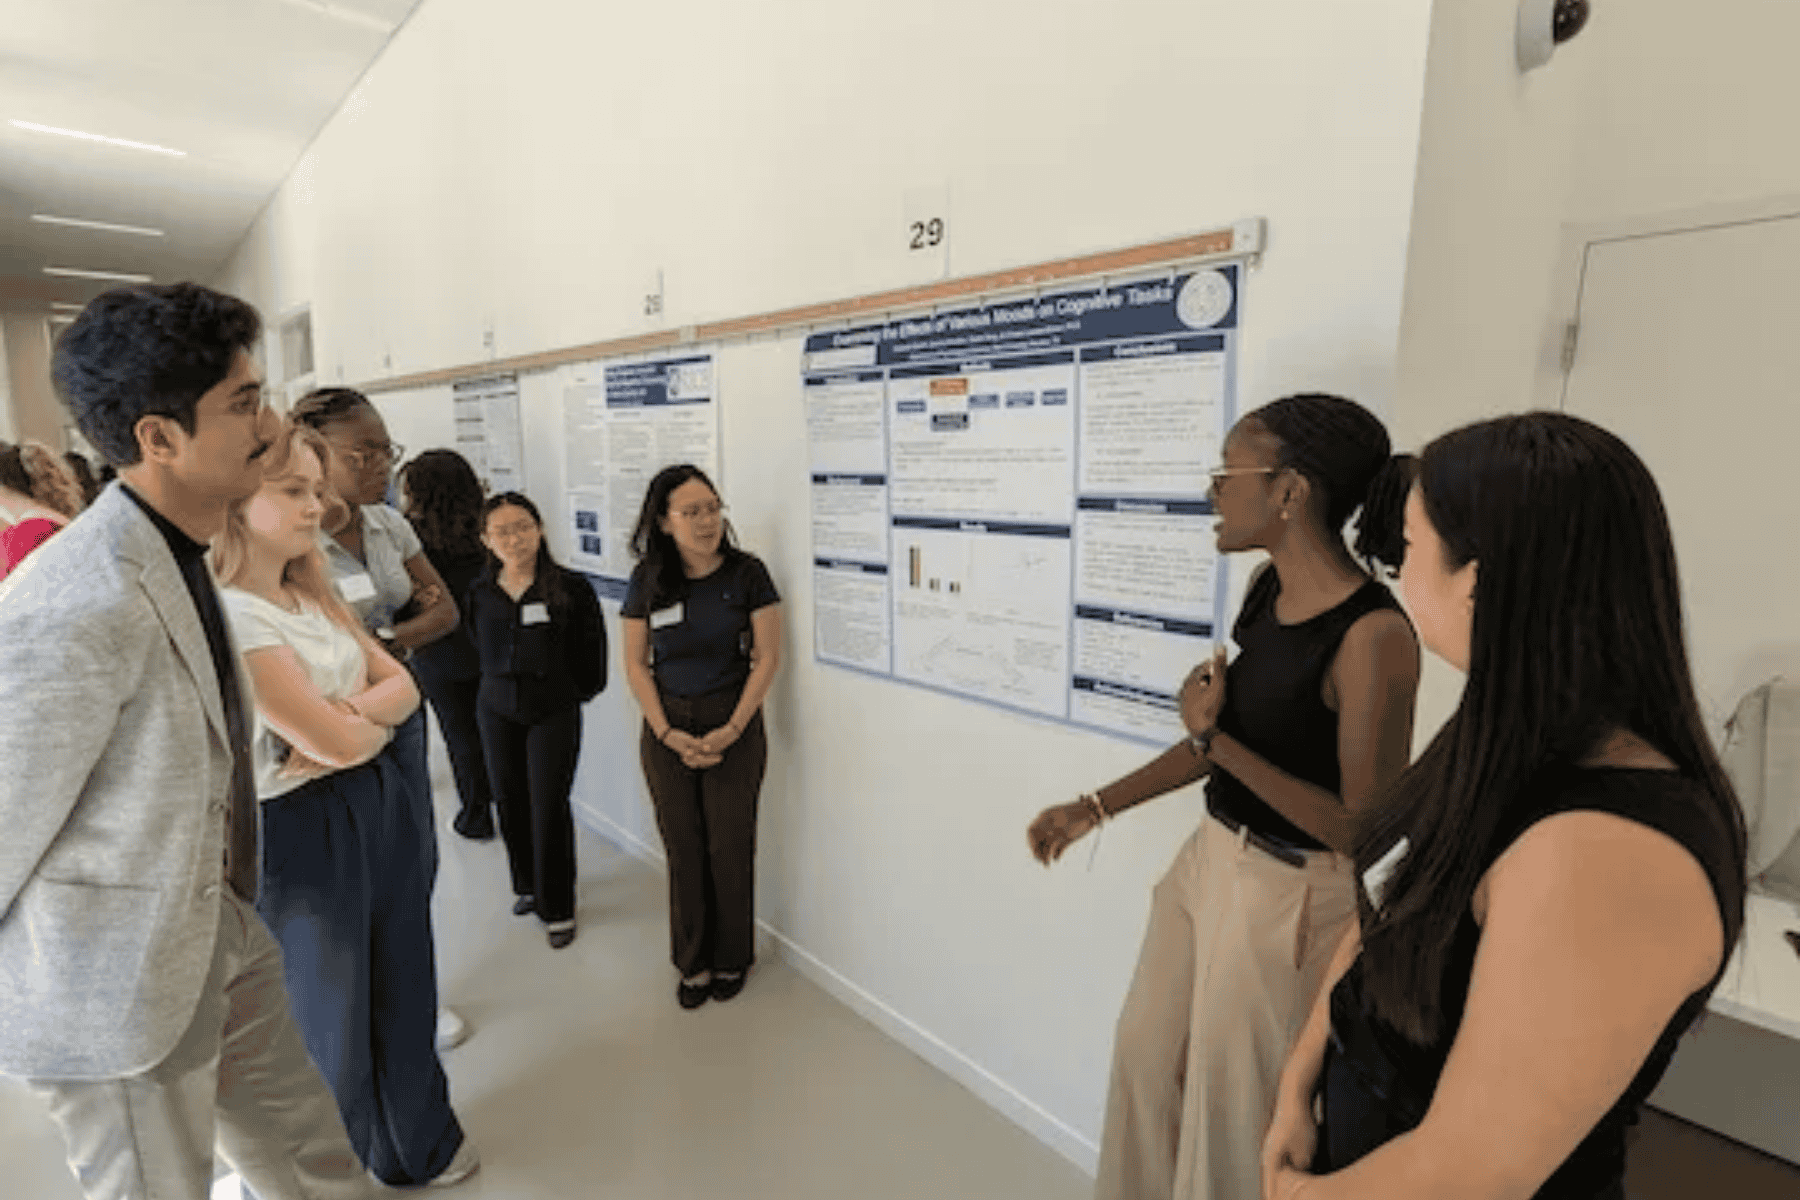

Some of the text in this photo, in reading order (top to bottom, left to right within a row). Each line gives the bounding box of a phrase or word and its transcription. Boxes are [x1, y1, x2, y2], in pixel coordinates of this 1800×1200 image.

[909, 217, 942, 249] 29
[1056, 293, 1123, 315] Cognitive
[1127, 284, 1174, 305] Tasks
